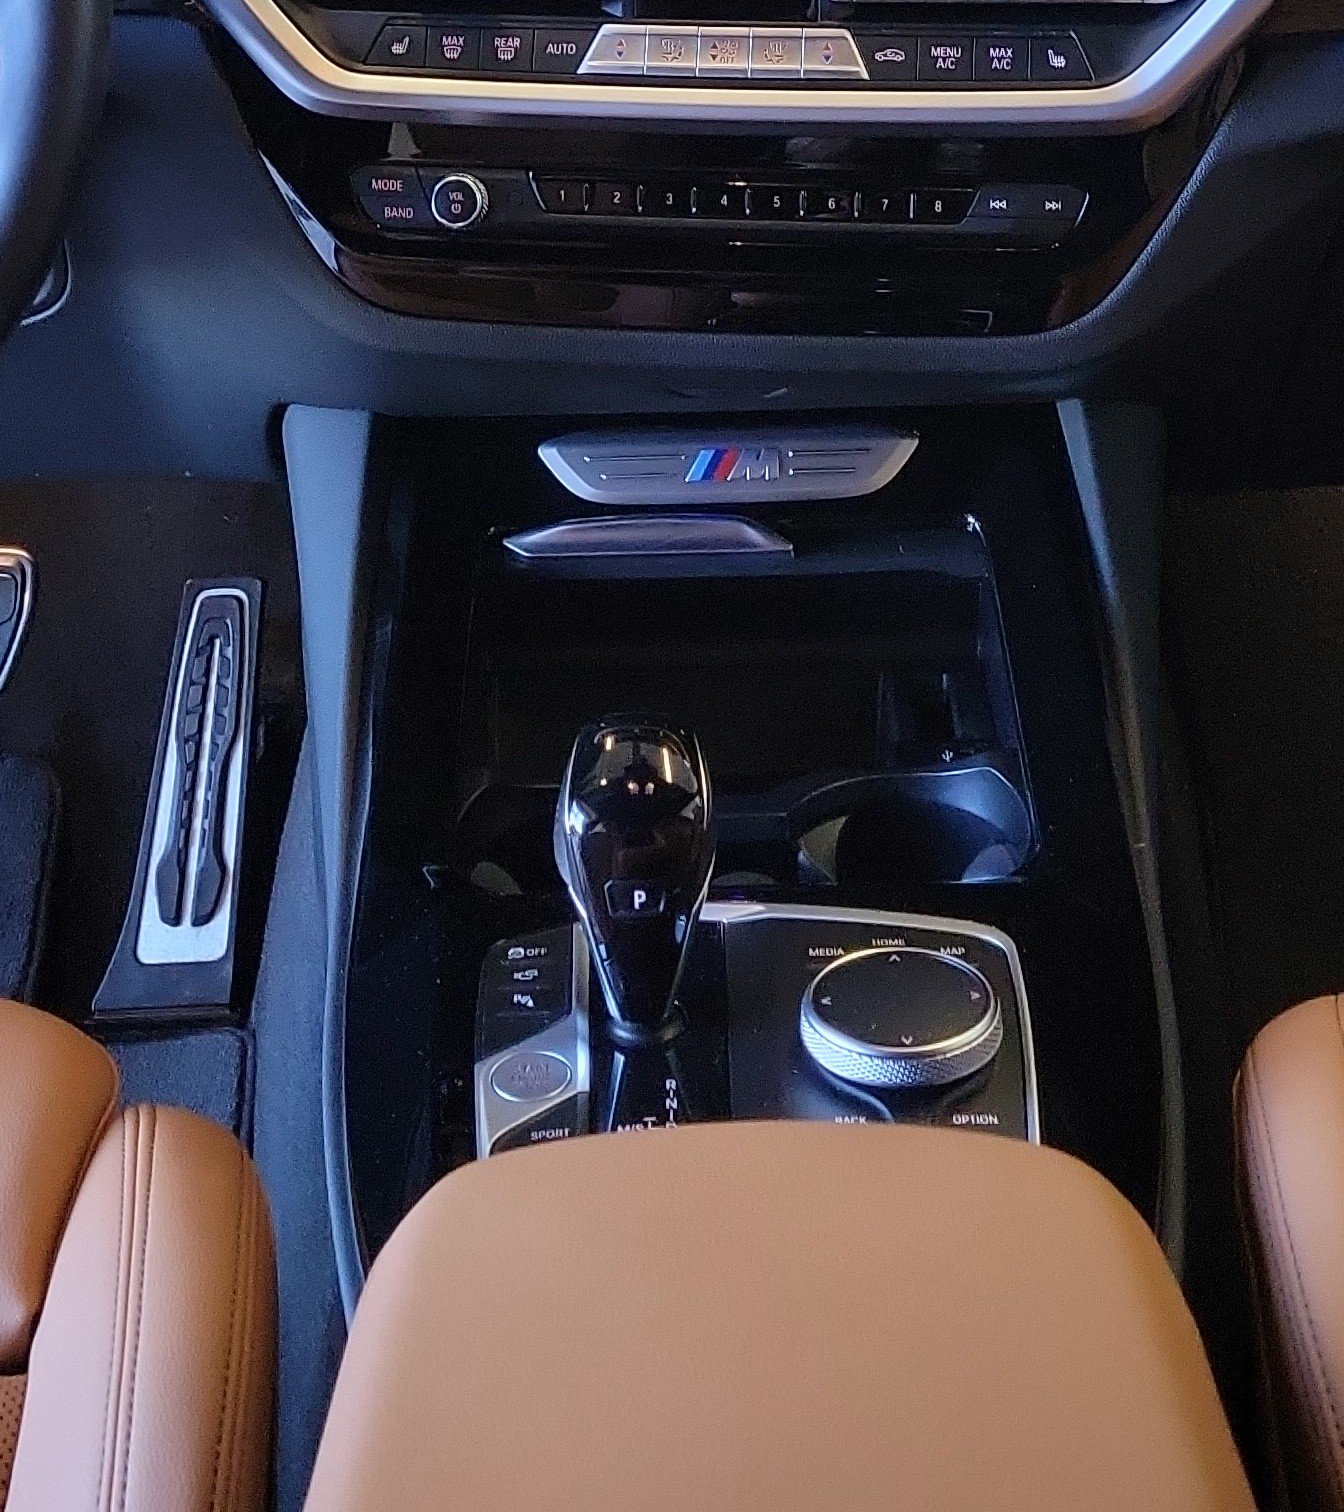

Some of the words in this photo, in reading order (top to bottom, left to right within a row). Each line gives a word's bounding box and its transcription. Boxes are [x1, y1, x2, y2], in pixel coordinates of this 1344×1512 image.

[442, 35, 464, 47] MAX
[494, 37, 520, 48] REAR
[546, 43, 576, 55] AUTO
[931, 45, 961, 58] MENU
[990, 47, 1013, 59] MAX
[937, 58, 956, 70] A/C
[992, 58, 1011, 70] A/C
[372, 178, 404, 192] MODE
[449, 191, 464, 201] VOL
[613, 192, 621, 204] 2
[666, 193, 673, 205] 3
[721, 194, 728, 206] 4
[773, 196, 780, 207] 5
[828, 198, 835, 209] 6
[882, 199, 888, 211] 7
[935, 200, 942, 212] 8
[384, 206, 414, 219] BAND
[633, 889, 647, 910] P
[526, 947, 547, 956] OFF
[808, 947, 845, 956] MEDIA
[940, 946, 965, 955] MAP
[666, 1078, 676, 1090] R
[666, 1099, 677, 1110] N
[952, 1114, 999, 1125] OPTION
[530, 1128, 570, 1140] SPORT
